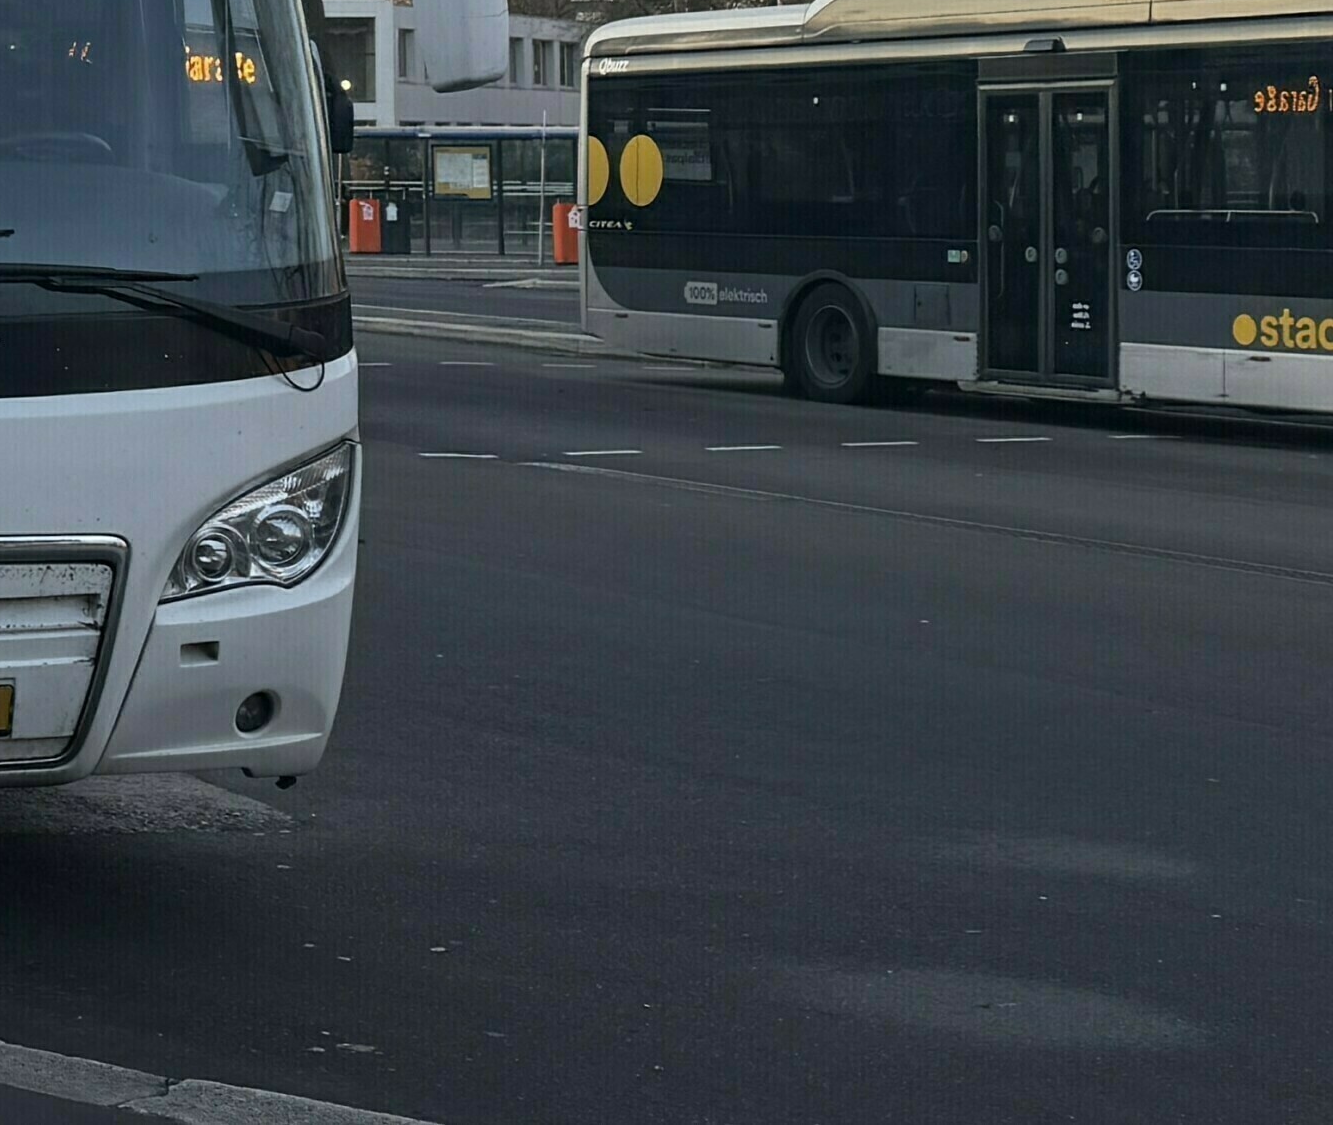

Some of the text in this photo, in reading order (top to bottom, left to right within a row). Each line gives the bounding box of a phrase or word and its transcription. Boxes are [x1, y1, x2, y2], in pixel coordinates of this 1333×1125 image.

[599, 58, 630, 76] Qbuzz
[689, 286, 768, 303] 100% elektrisch
